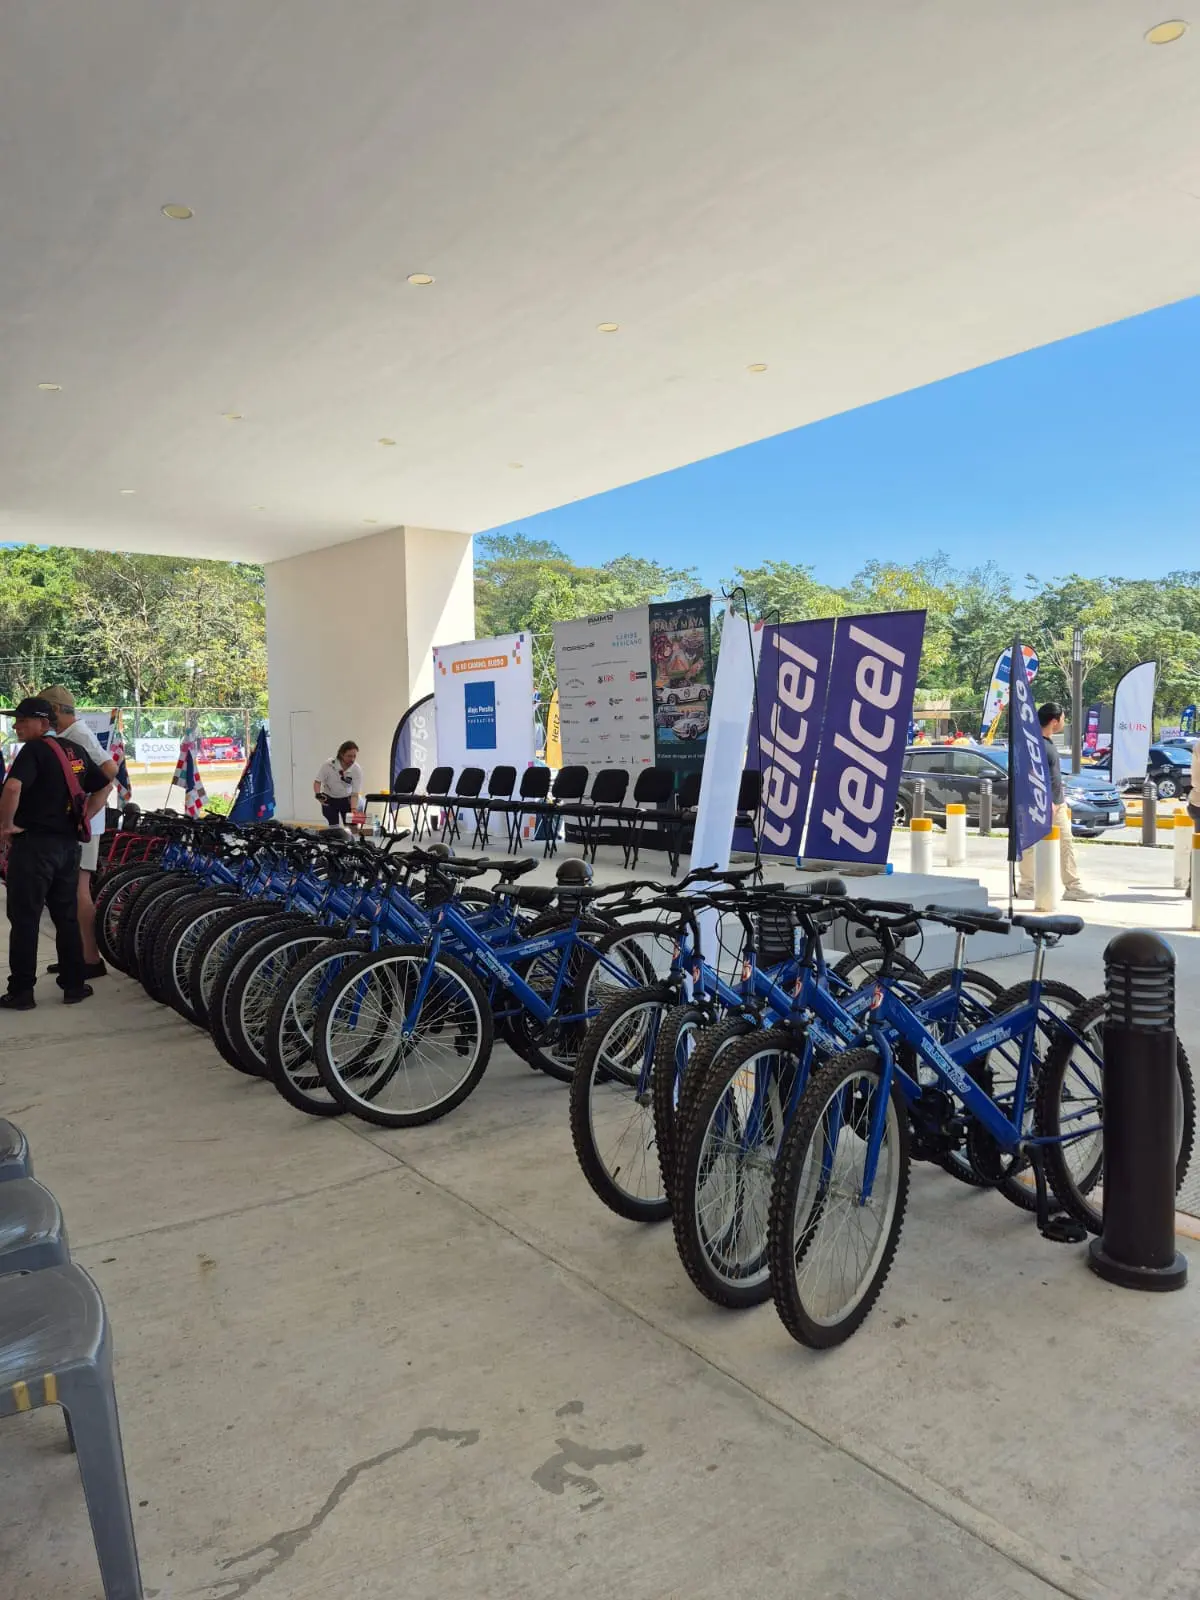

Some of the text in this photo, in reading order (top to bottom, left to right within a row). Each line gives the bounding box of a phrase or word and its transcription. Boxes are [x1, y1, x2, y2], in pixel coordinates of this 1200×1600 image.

[411, 714, 429, 741] 5G
[551, 713, 562, 743] Hertz
[747, 632, 818, 847] telcel
[822, 624, 905, 853] telcel
[1128, 723, 1148, 732] UBS
[151, 743, 176, 753] OASIS
[1022, 726, 1048, 826] telcel
